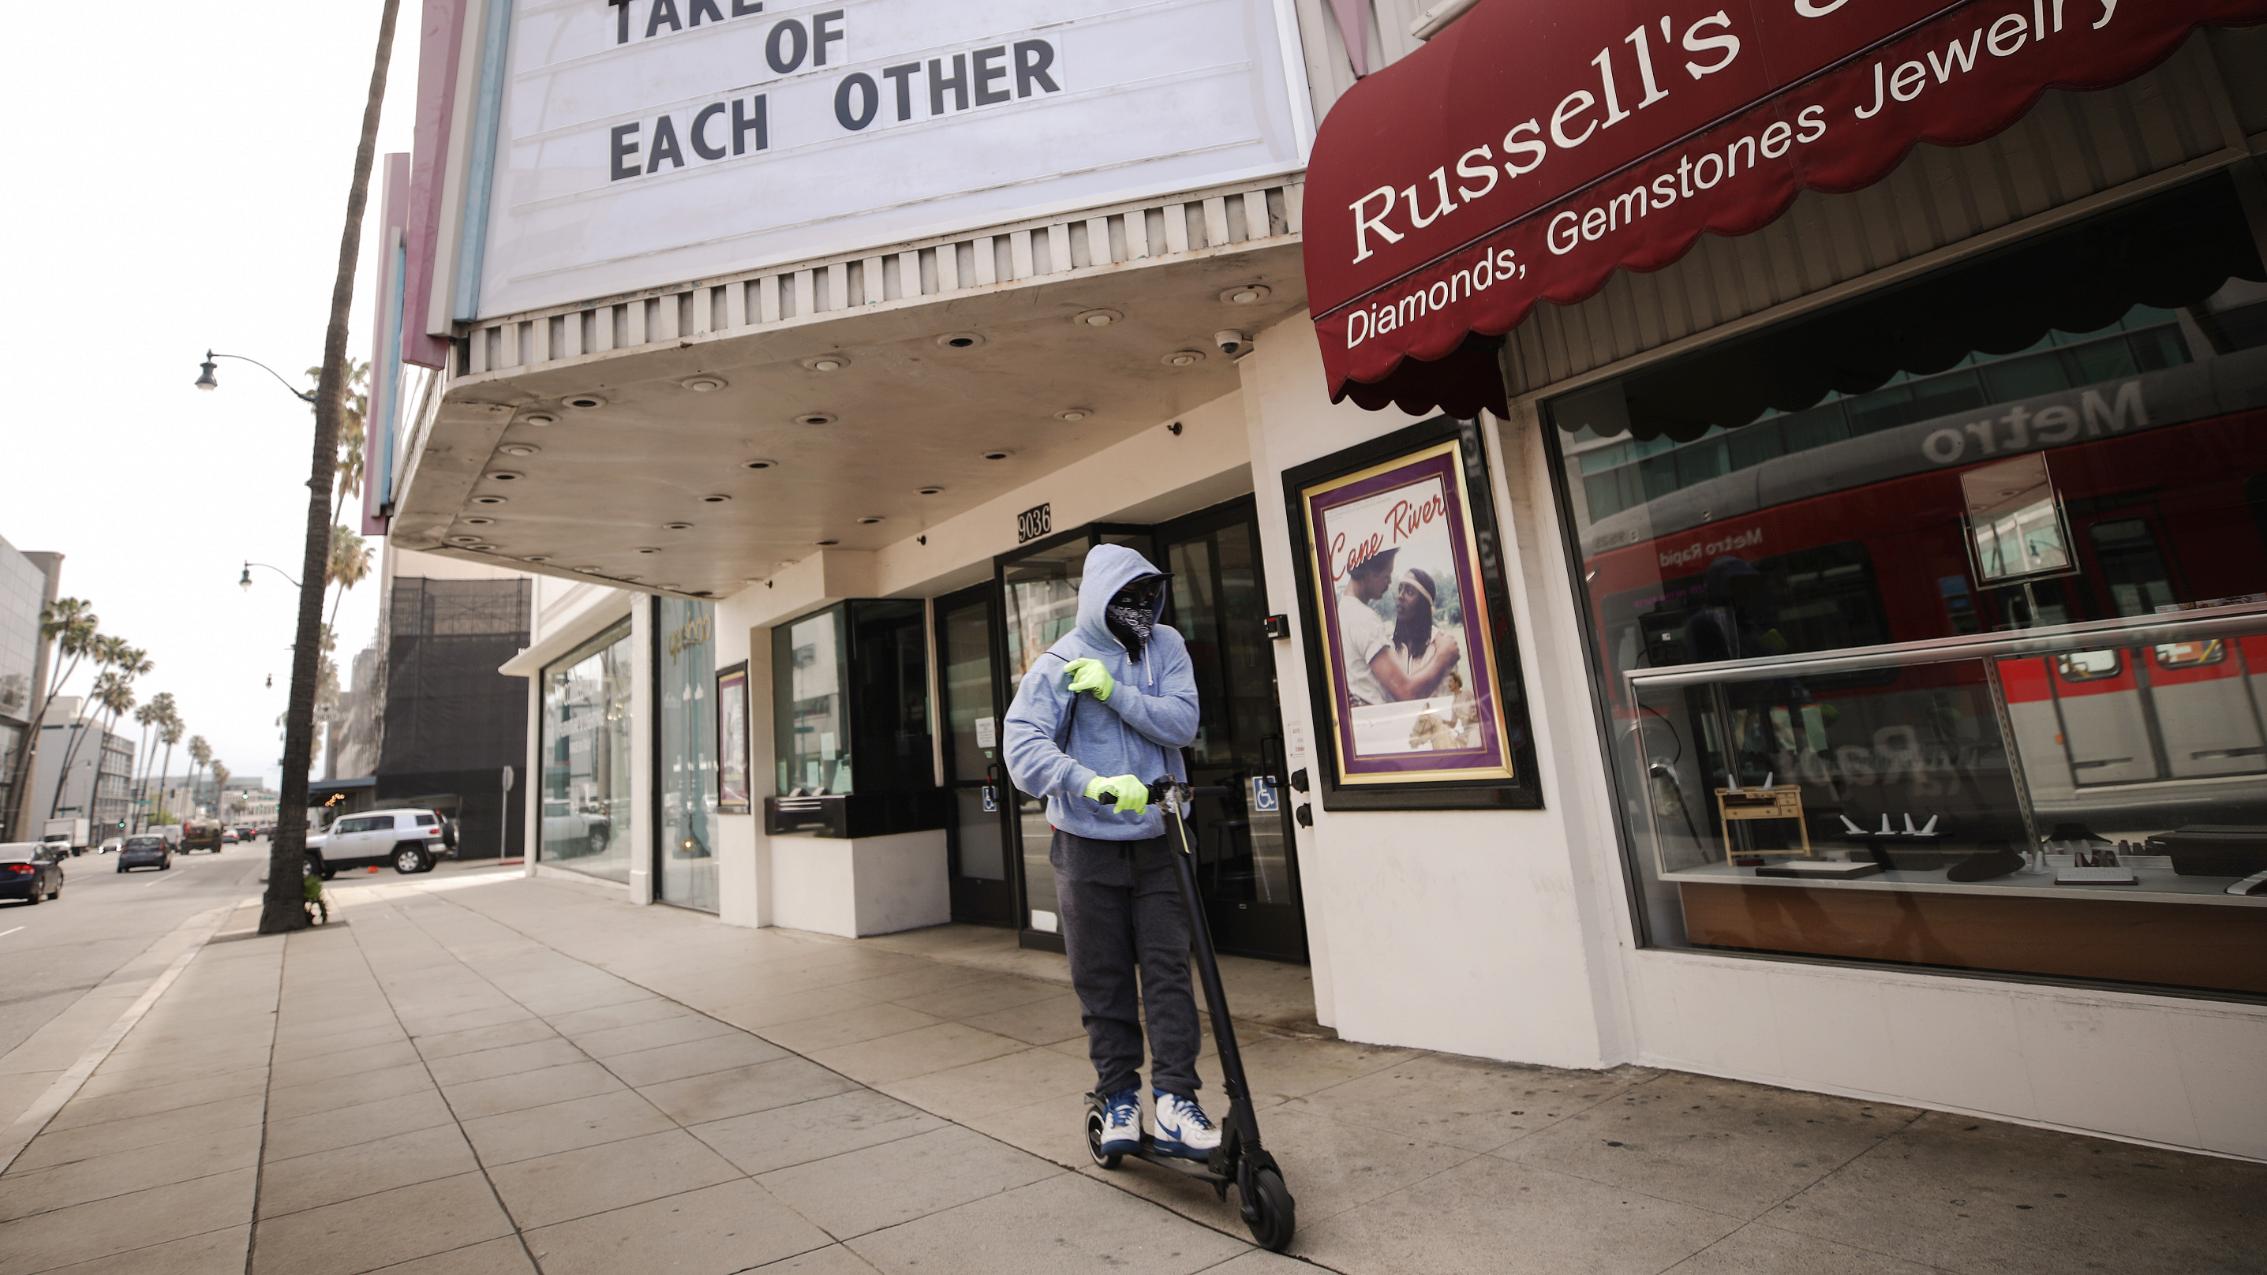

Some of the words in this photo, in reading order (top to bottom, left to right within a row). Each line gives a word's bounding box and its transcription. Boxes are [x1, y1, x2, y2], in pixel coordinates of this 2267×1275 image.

[765, 10, 844, 74] OF
[611, 94, 768, 182] EACH
[834, 39, 1061, 131] OTHER
[1349, 10, 1741, 265] Russell's
[1346, 247, 1527, 349] Diamonds,
[1546, 104, 1827, 256] Gemstones
[1018, 505, 1051, 542] 9036
[1329, 532, 1384, 581] Cane
[1384, 494, 1446, 544] River
